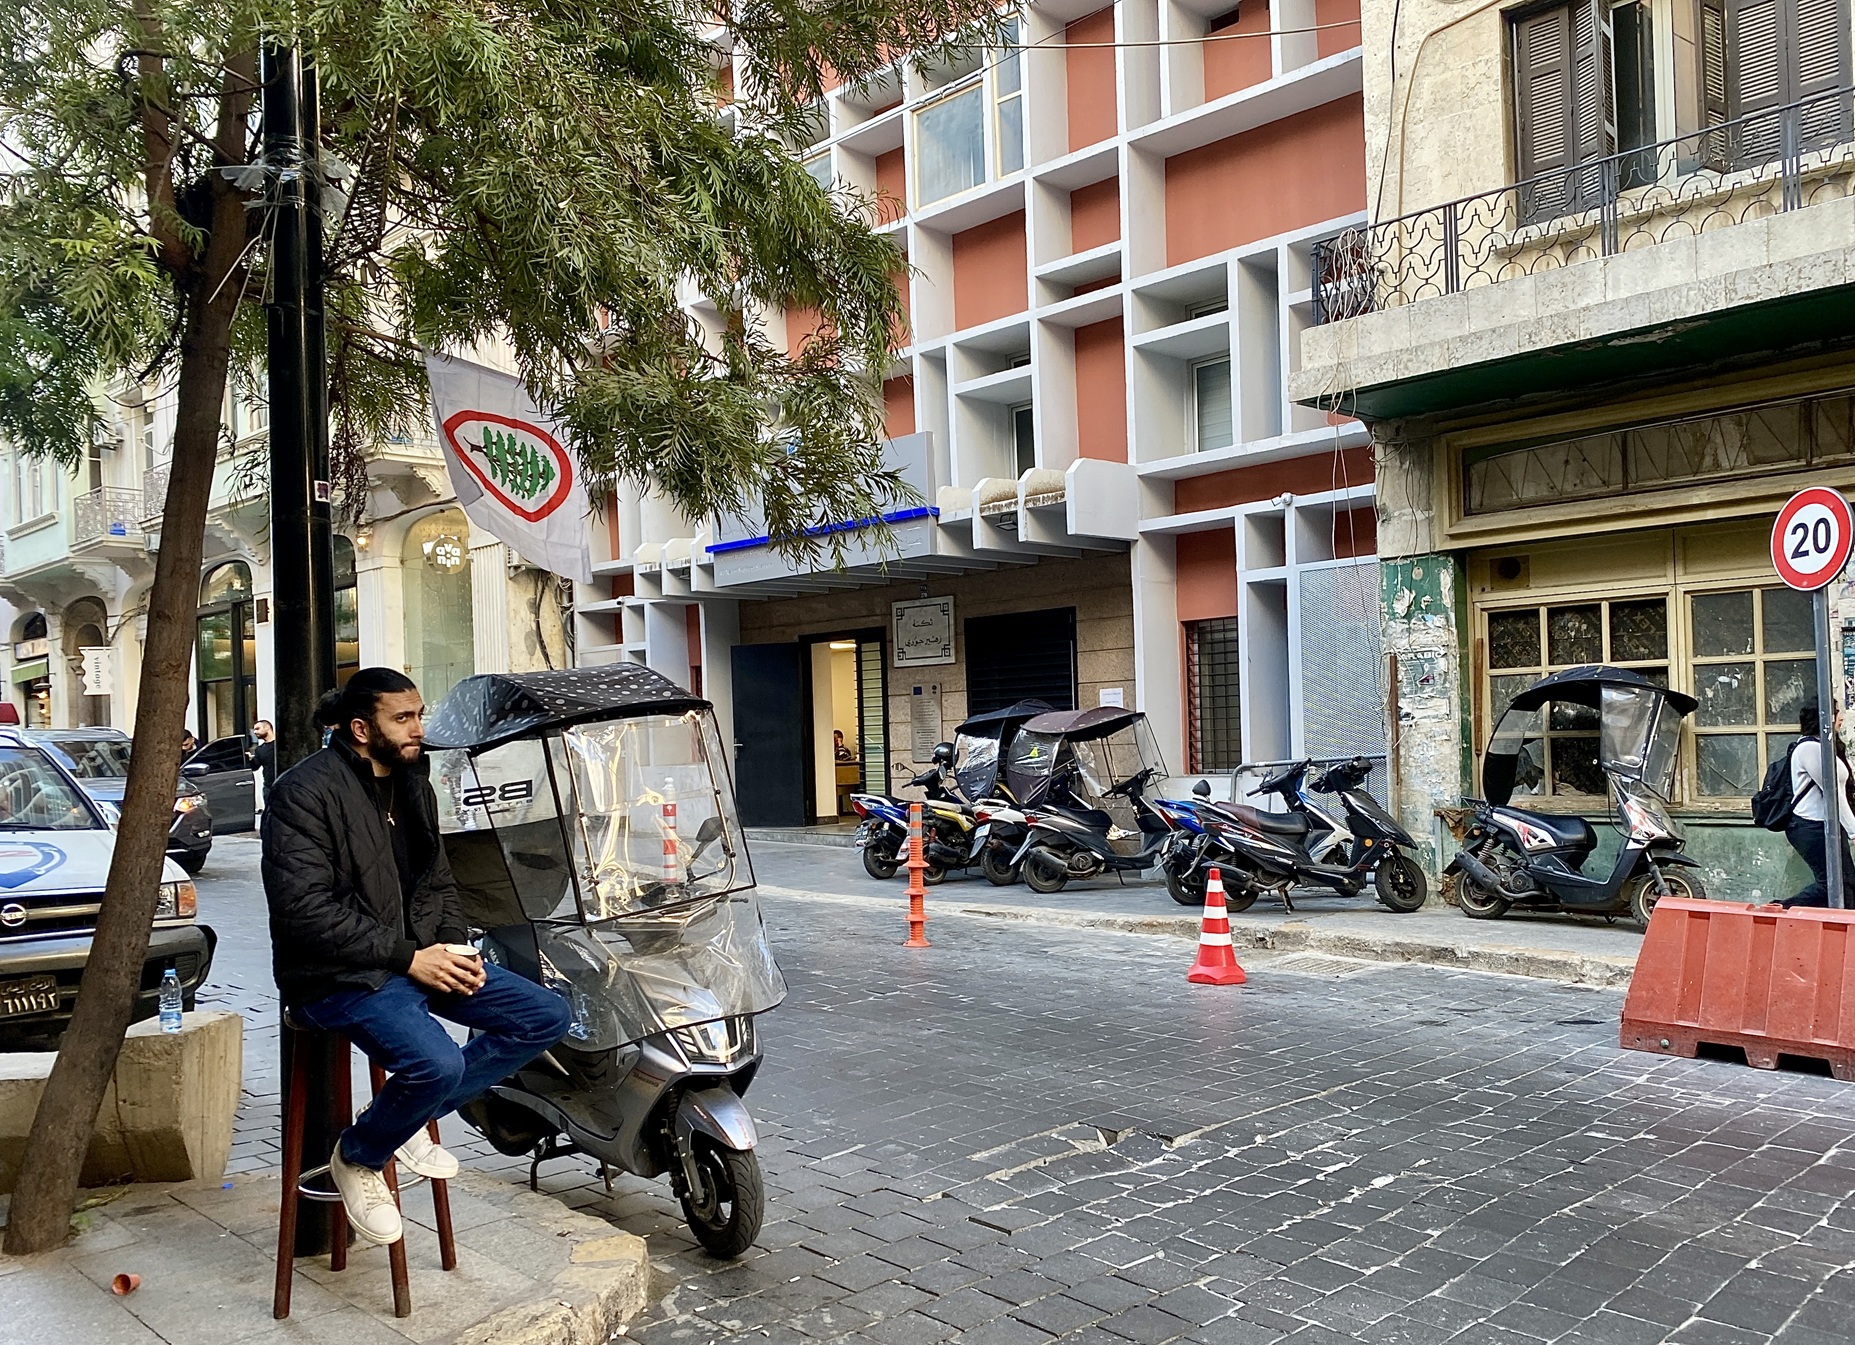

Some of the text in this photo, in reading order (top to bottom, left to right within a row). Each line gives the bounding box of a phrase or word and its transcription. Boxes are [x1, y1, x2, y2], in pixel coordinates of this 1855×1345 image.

[1790, 517, 1831, 560] 20
[912, 618, 934, 628] ثكنة
[93, 656, 102, 689] vintage
